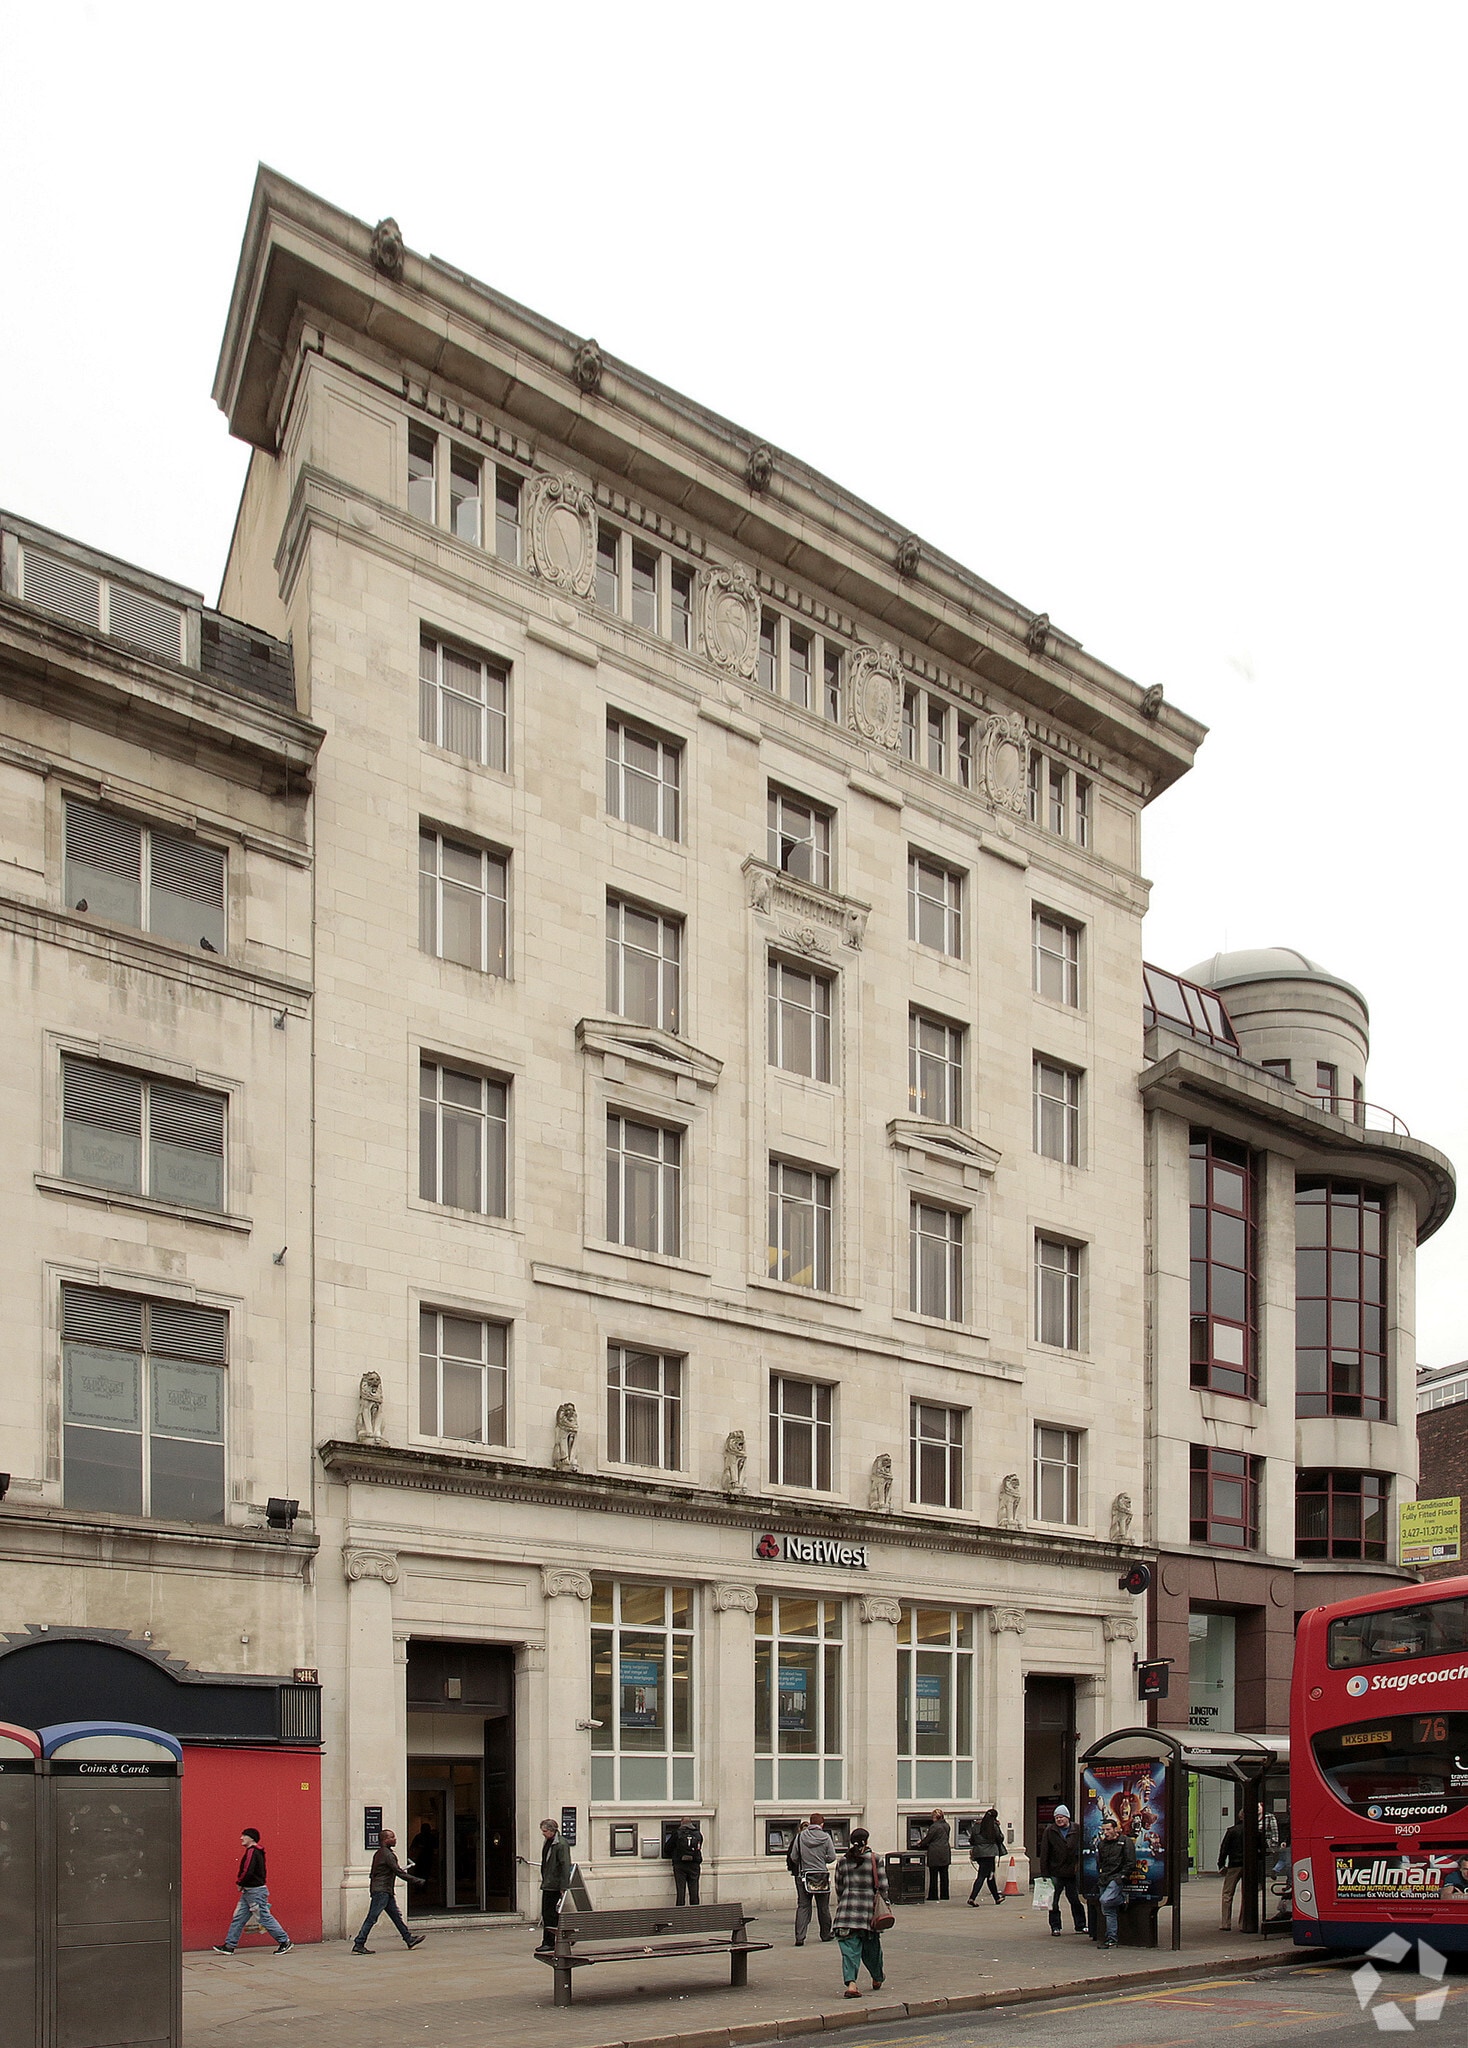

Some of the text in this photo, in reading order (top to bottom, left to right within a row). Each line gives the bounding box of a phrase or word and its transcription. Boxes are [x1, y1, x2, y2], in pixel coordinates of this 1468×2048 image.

[1417, 1500, 1453, 1510] Conditioned
[1444, 1524, 1458, 1535] sqft
[784, 1536, 870, 1567] NatWest
[1371, 1665, 1468, 1691] Stagecoach
[1419, 1717, 1446, 1742] 76
[1370, 1732, 1389, 1742] FSS
[79, 1763, 150, 1774] Coins & Cards
[1384, 1804, 1447, 1818] Stagecoach
[1395, 1825, 1420, 1834] 19400
[1336, 1861, 1441, 1885] wellman
[1400, 1891, 1439, 1899] Champion
